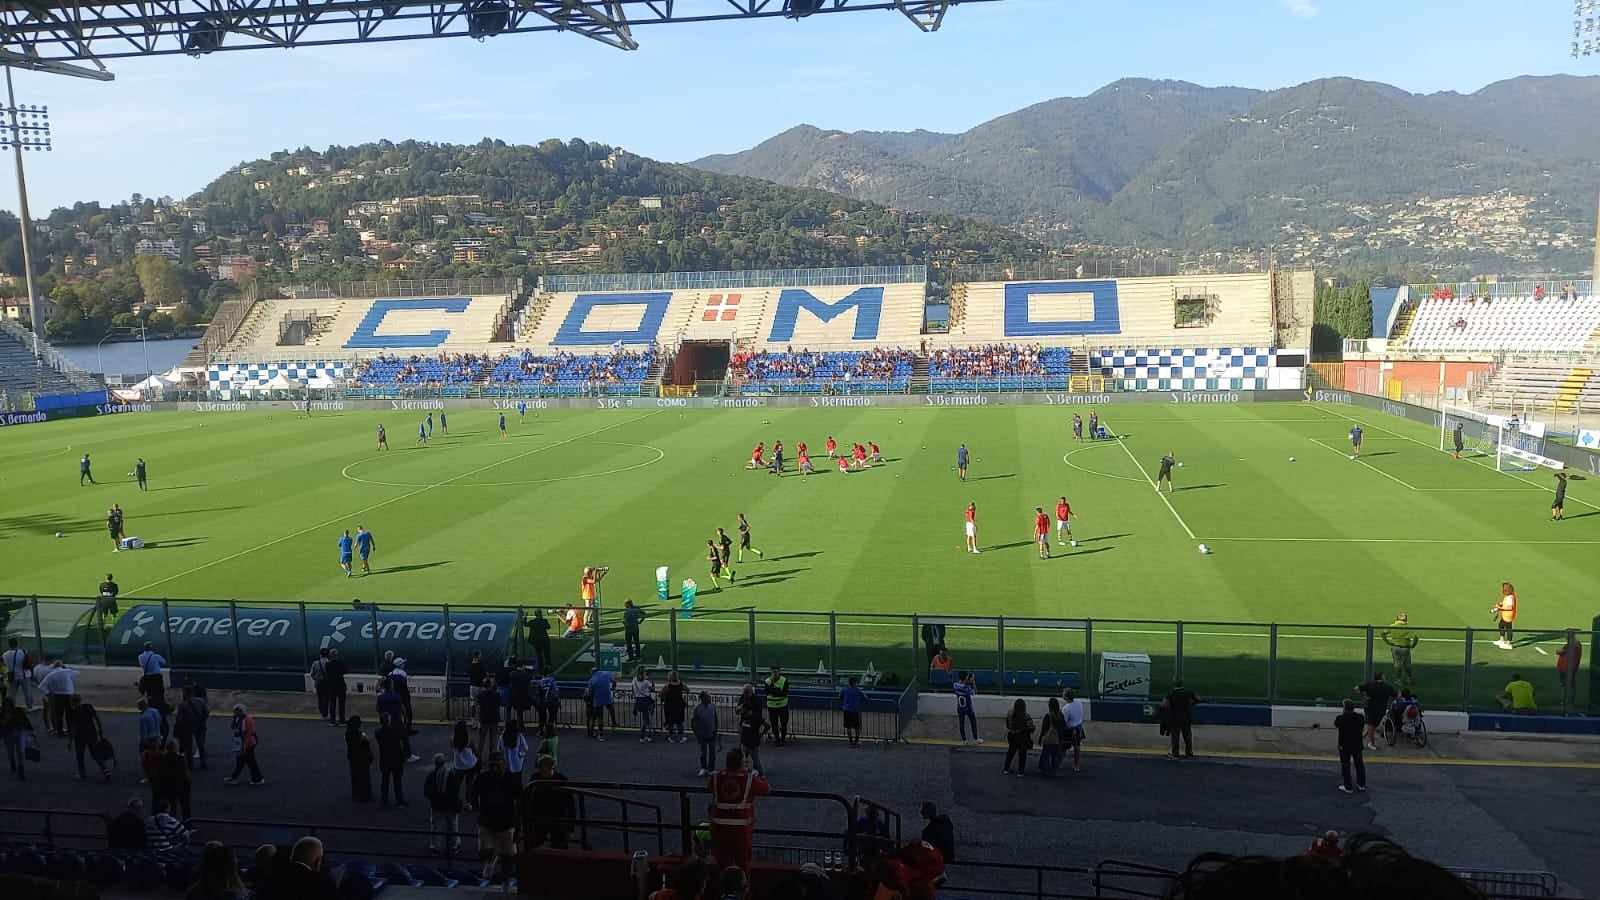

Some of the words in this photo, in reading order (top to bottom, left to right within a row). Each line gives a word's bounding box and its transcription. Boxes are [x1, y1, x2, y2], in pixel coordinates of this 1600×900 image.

[656, 398, 687, 407] COMO
[161, 614, 291, 637] emeren
[361, 618, 497, 642] emeren
